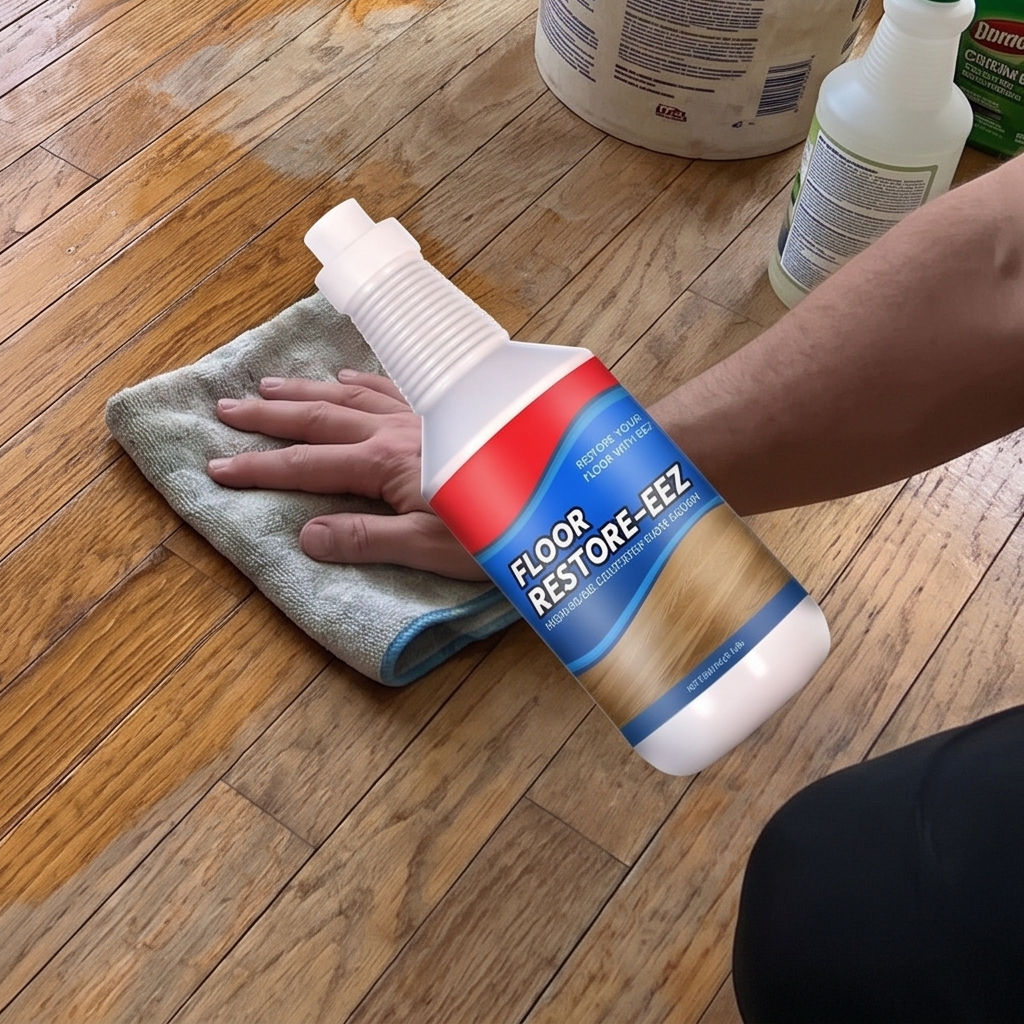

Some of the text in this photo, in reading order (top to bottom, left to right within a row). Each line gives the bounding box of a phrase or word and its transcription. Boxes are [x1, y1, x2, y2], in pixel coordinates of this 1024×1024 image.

[613, 413, 642, 437] YOUR
[509, 507, 591, 588] FLOOR
[526, 463, 692, 618] RESTORE-EEZ
